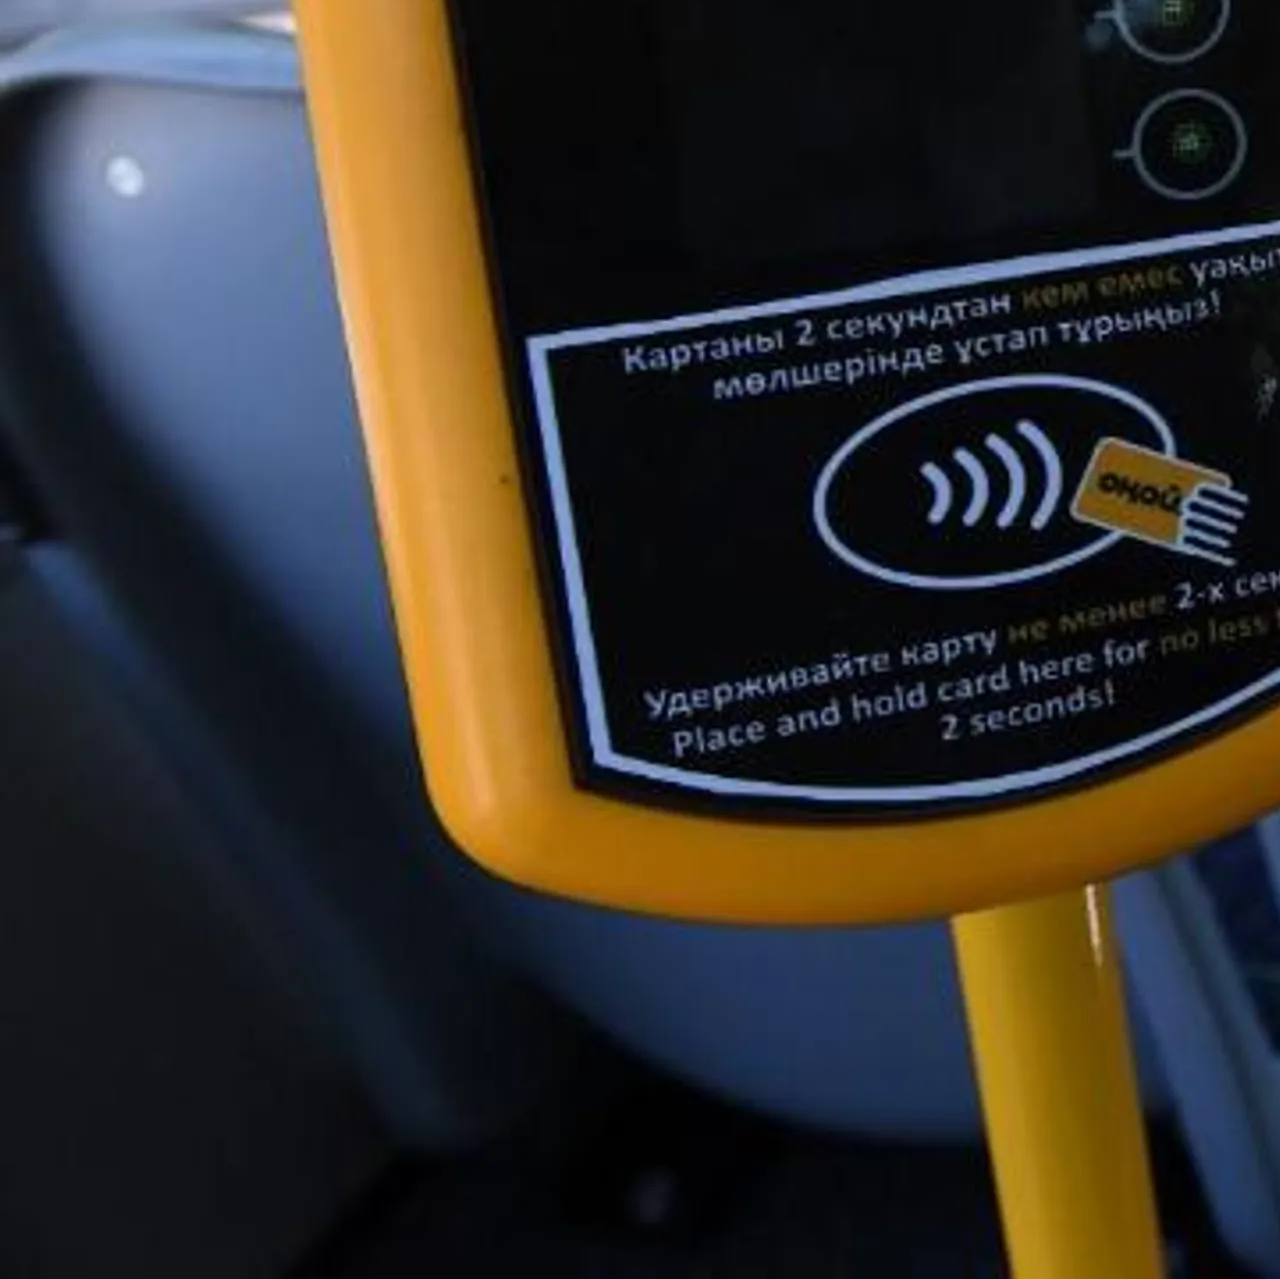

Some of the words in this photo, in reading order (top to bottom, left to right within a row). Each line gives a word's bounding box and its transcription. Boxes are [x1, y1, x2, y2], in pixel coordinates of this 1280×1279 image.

[623, 327, 785, 376] Картаны
[793, 318, 816, 347] 2
[825, 291, 1012, 341] секундтан
[1021, 279, 1090, 311] кем
[1096, 262, 1185, 299] емес
[713, 342, 944, 400] мөлшерінде
[955, 322, 1050, 365] ұстап
[642, 650, 892, 720] Удерживайте
[902, 628, 997, 665] карту
[1007, 617, 1051, 643] не
[1060, 594, 1167, 636] менее
[1174, 580, 1226, 610] 2-х
[672, 720, 767, 758] Place
[775, 698, 841, 738] and
[852, 681, 928, 722] hold
[937, 662, 1012, 702] card
[1018, 649, 1097, 686] here
[1101, 638, 1151, 668] for
[1160, 627, 1201, 656] no
[1208, 613, 1271, 643] less
[940, 713, 961, 741] 2
[969, 678, 1117, 737] seconds!
